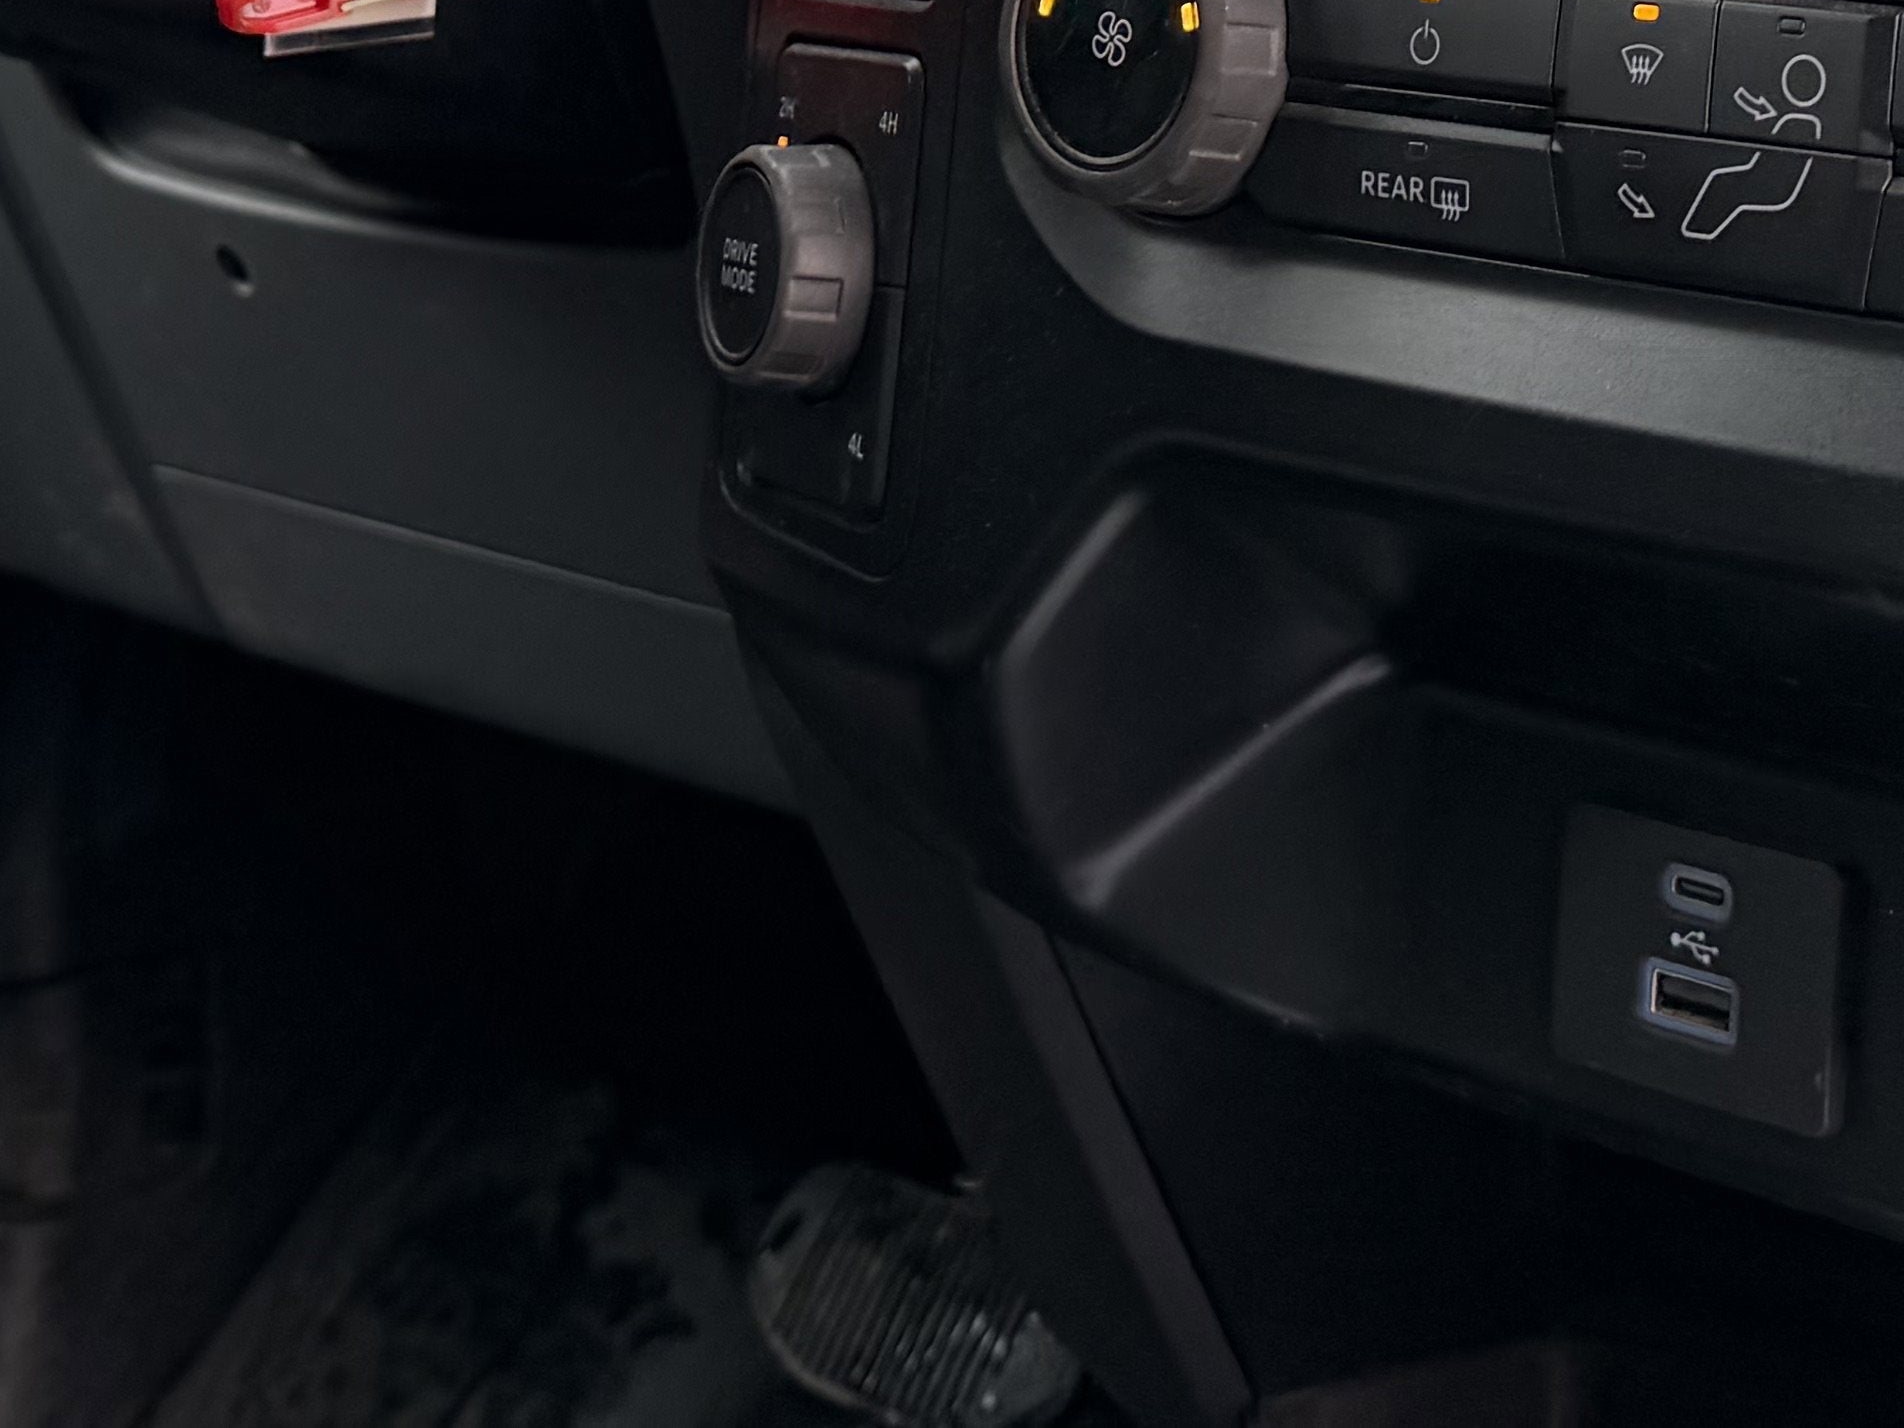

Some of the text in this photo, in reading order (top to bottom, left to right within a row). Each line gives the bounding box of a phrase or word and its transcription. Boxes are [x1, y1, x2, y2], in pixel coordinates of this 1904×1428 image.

[879, 111, 899, 135] 4H
[1360, 170, 1424, 203] REAR
[722, 237, 758, 265] DRIVE
[720, 266, 755, 294] MODE
[848, 432, 863, 460] 4L
